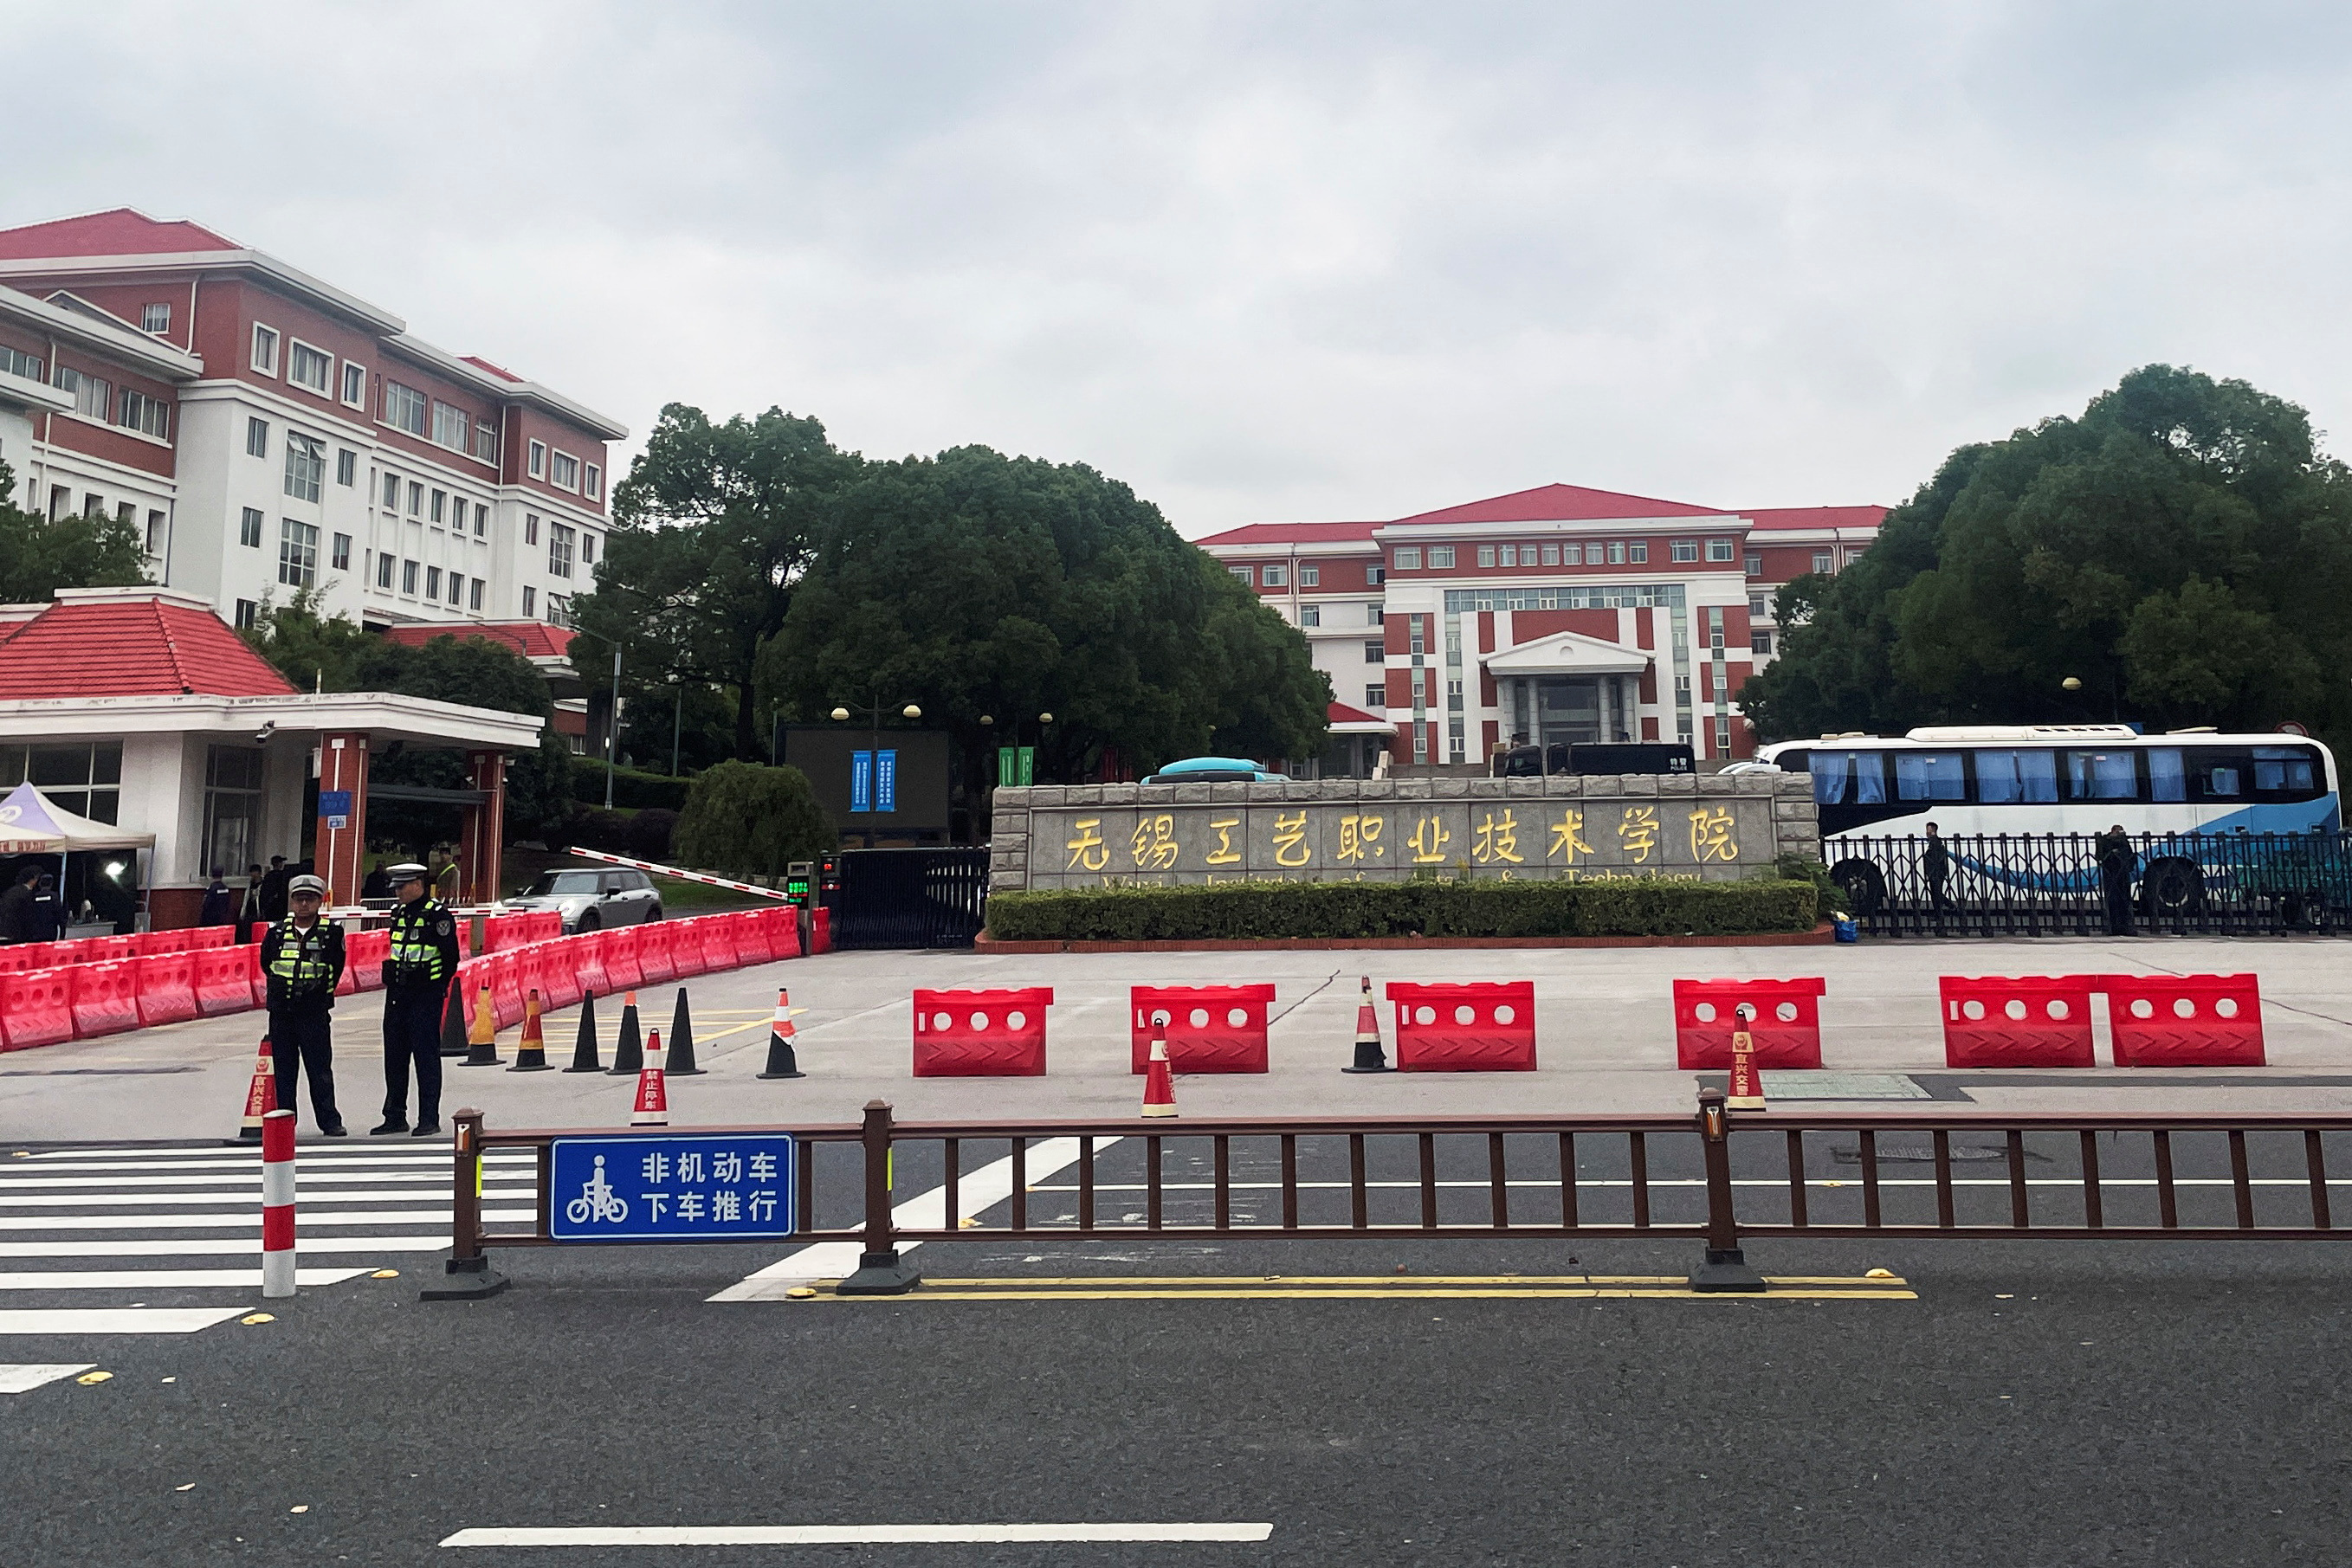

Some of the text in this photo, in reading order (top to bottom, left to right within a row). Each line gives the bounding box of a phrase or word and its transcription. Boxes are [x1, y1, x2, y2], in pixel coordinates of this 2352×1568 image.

[1066, 806, 1738, 871] 无锡工艺职业技术学院
[642, 1152, 778, 1184] 非机动车
[641, 1190, 778, 1223] 下车推行
